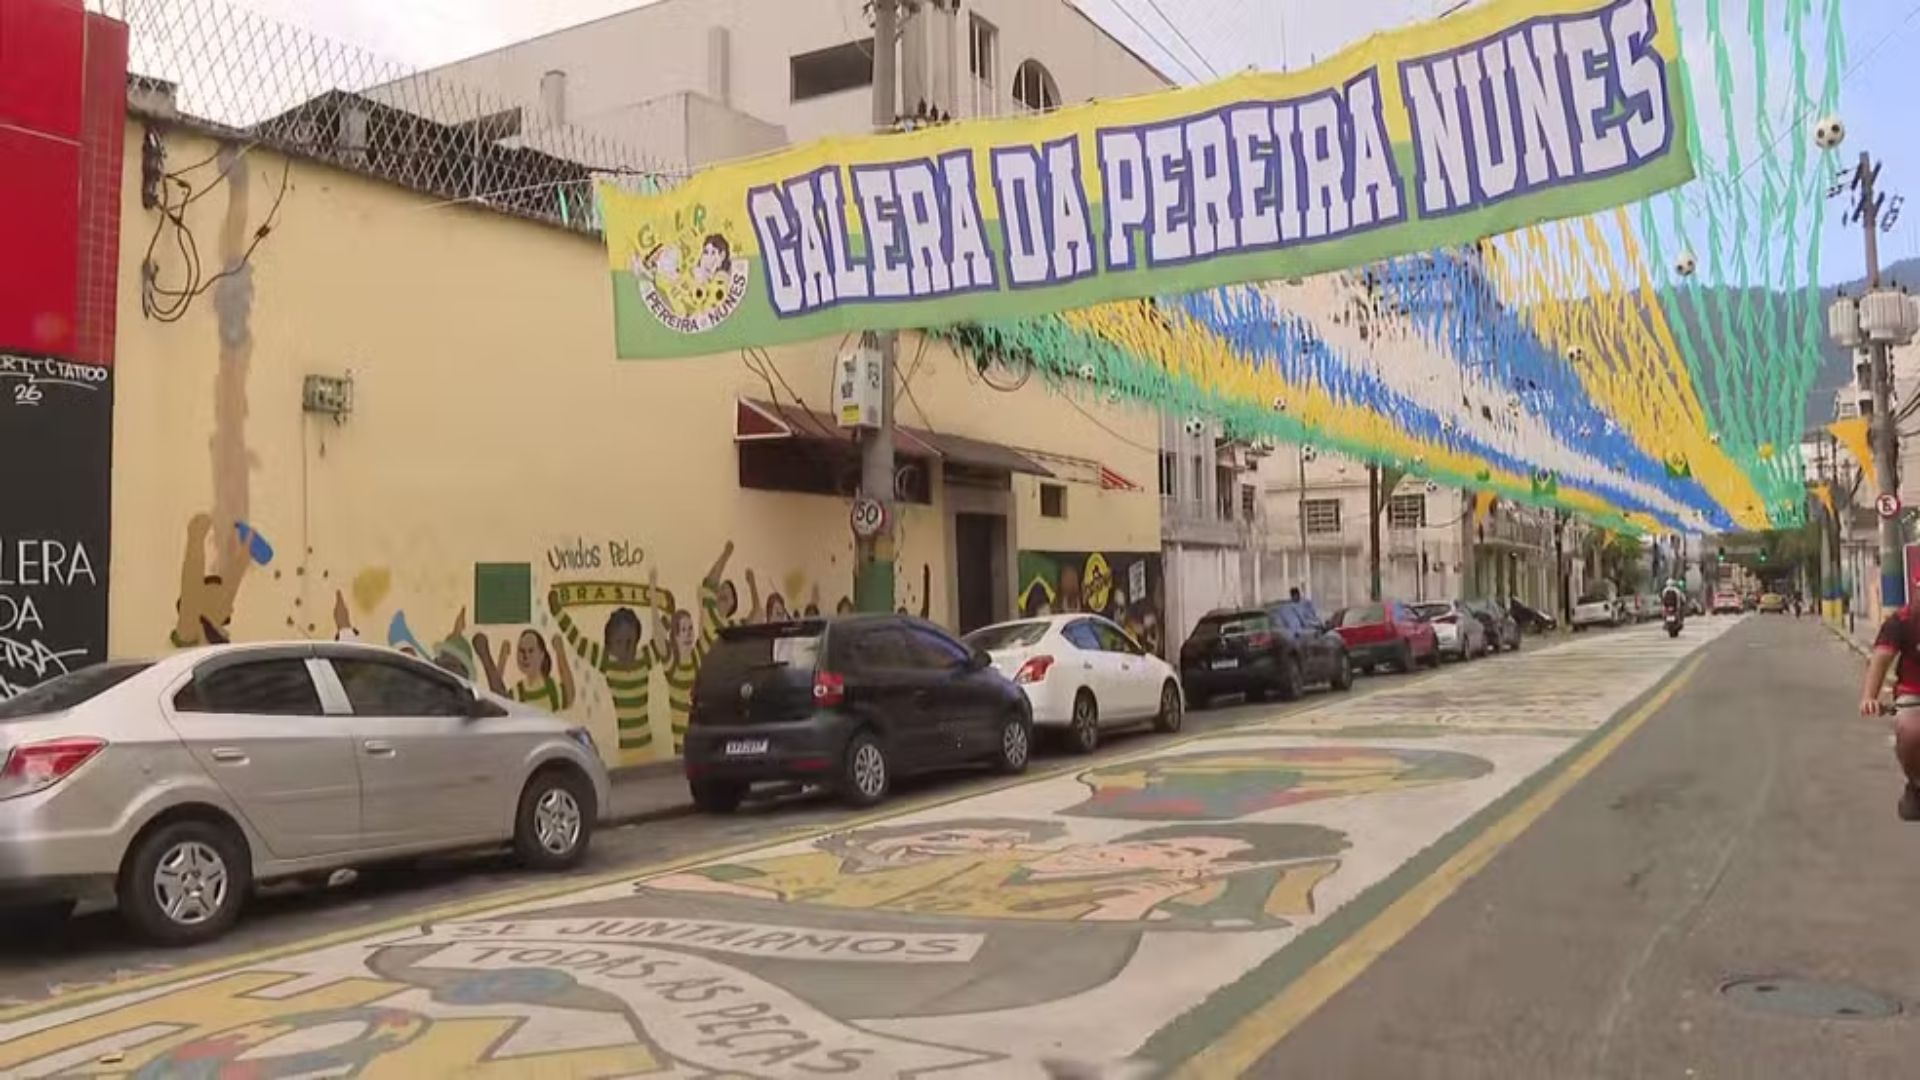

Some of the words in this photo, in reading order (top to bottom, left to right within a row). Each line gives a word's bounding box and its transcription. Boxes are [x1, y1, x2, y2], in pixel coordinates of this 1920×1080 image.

[749, 153, 996, 317] GALERA
[991, 135, 1097, 288] DA
[1097, 66, 1404, 270] PEREIRA
[1401, 0, 1674, 218] NUNES
[646, 291, 699, 332] PEREIRA
[708, 274, 746, 325] NUNES
[15, 384, 42, 401] 26
[856, 501, 879, 525] 50
[450, 923, 525, 938] SE
[556, 920, 963, 957] JUNTARMOS
[470, 946, 682, 980] TODAS
[643, 976, 745, 1003] AS
